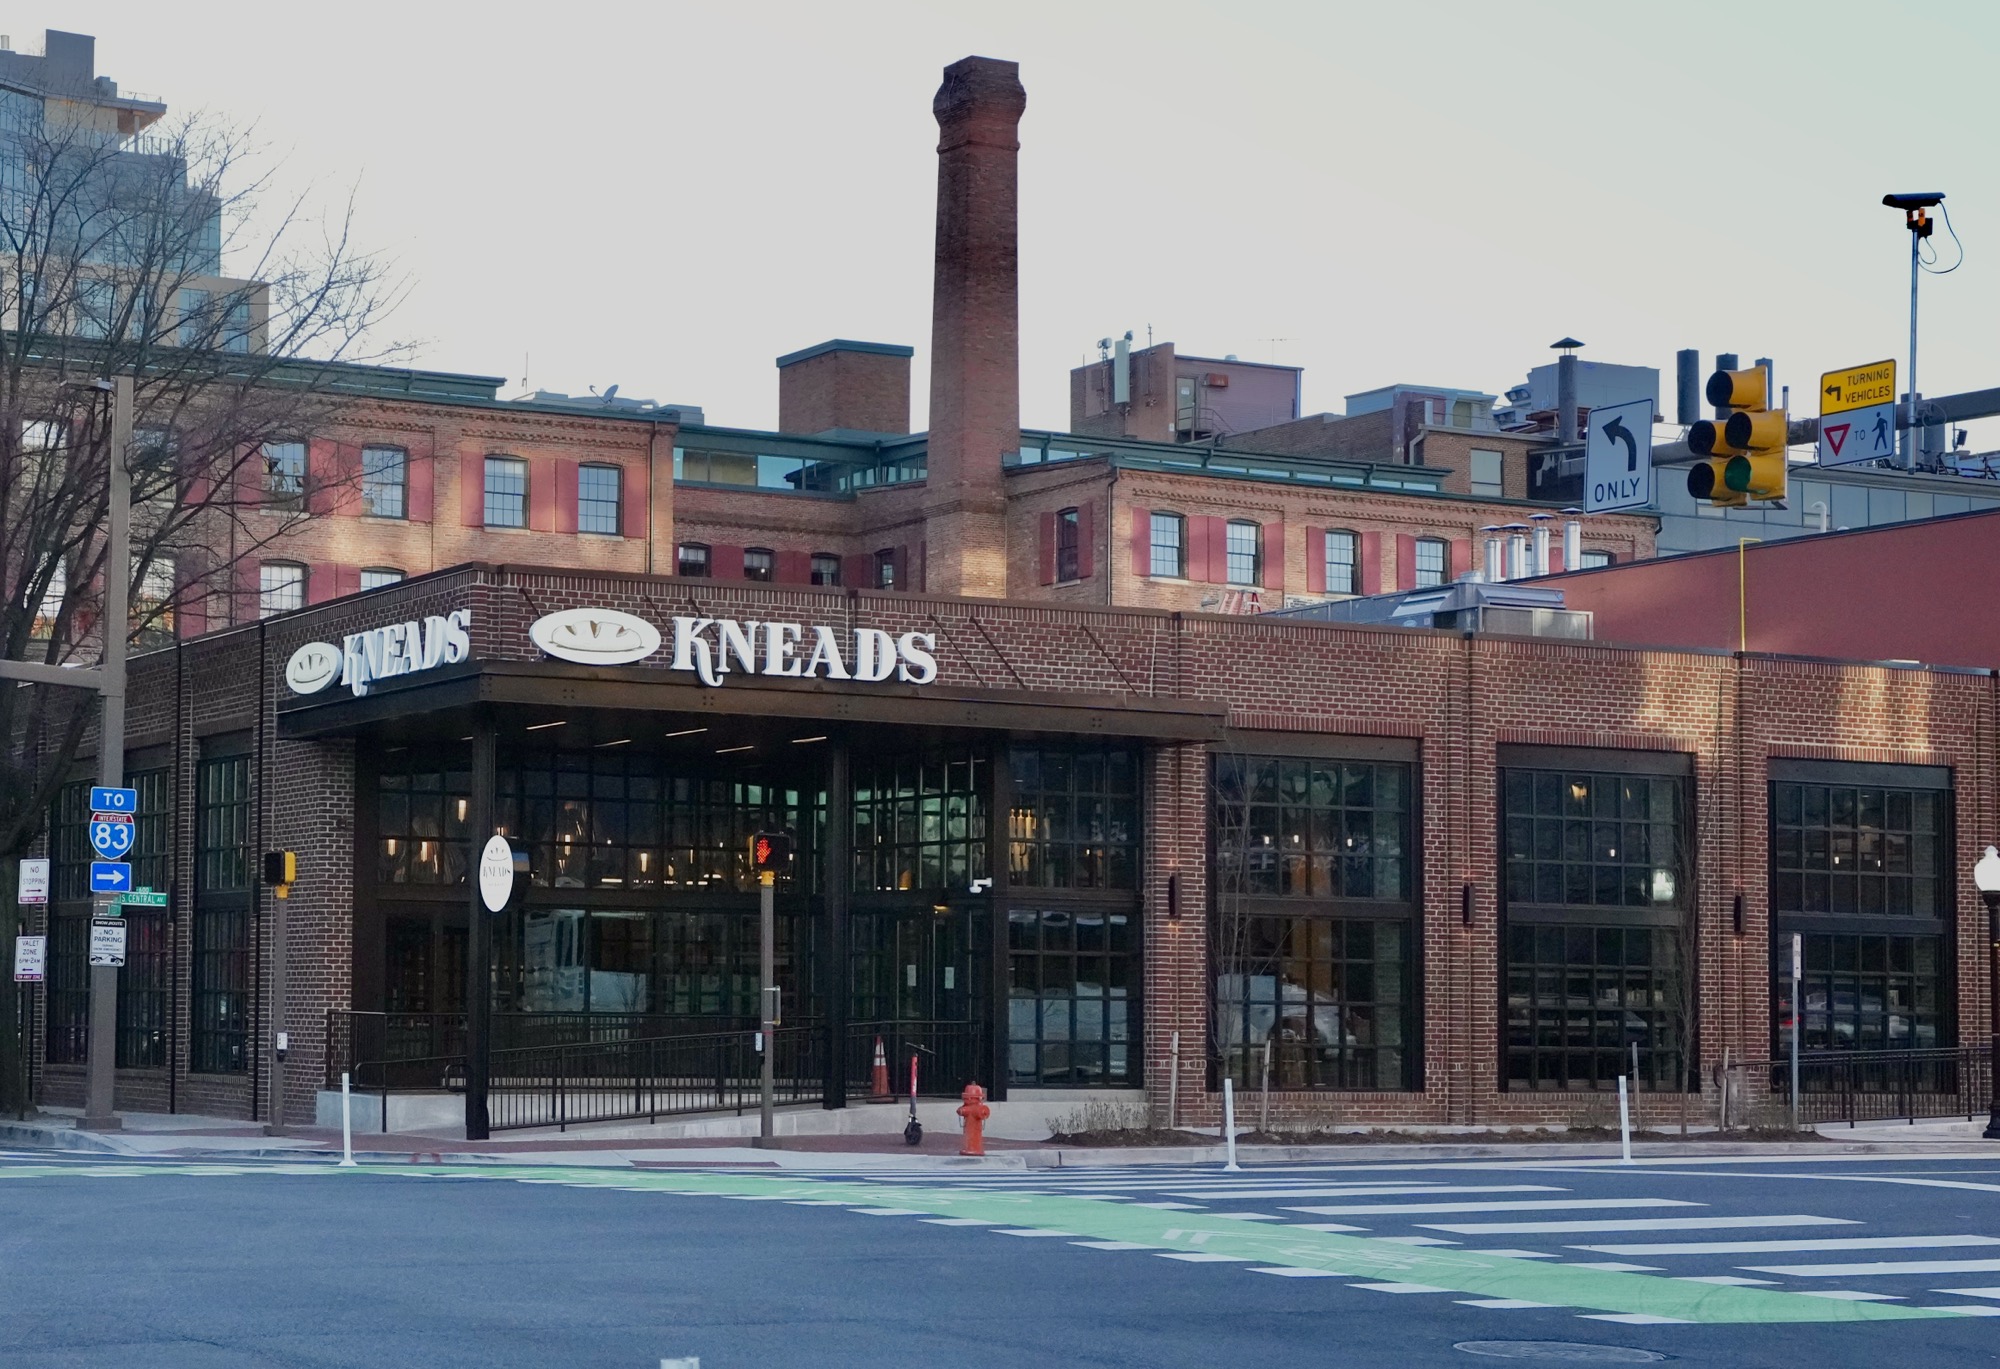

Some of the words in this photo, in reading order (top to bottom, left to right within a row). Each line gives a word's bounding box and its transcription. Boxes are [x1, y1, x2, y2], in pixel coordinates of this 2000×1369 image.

[1847, 368, 1890, 386] TURNING
[1845, 385, 1891, 404] VEHICLES
[1854, 429, 1866, 441] TO
[1594, 477, 1640, 503] ONLY
[340, 608, 472, 697] KNEADS
[670, 616, 938, 687] KNEADS
[103, 793, 125, 807] TO
[97, 815, 128, 823] INTERSTATE
[95, 823, 129, 850] 83
[128, 894, 156, 904] CENTRAL
